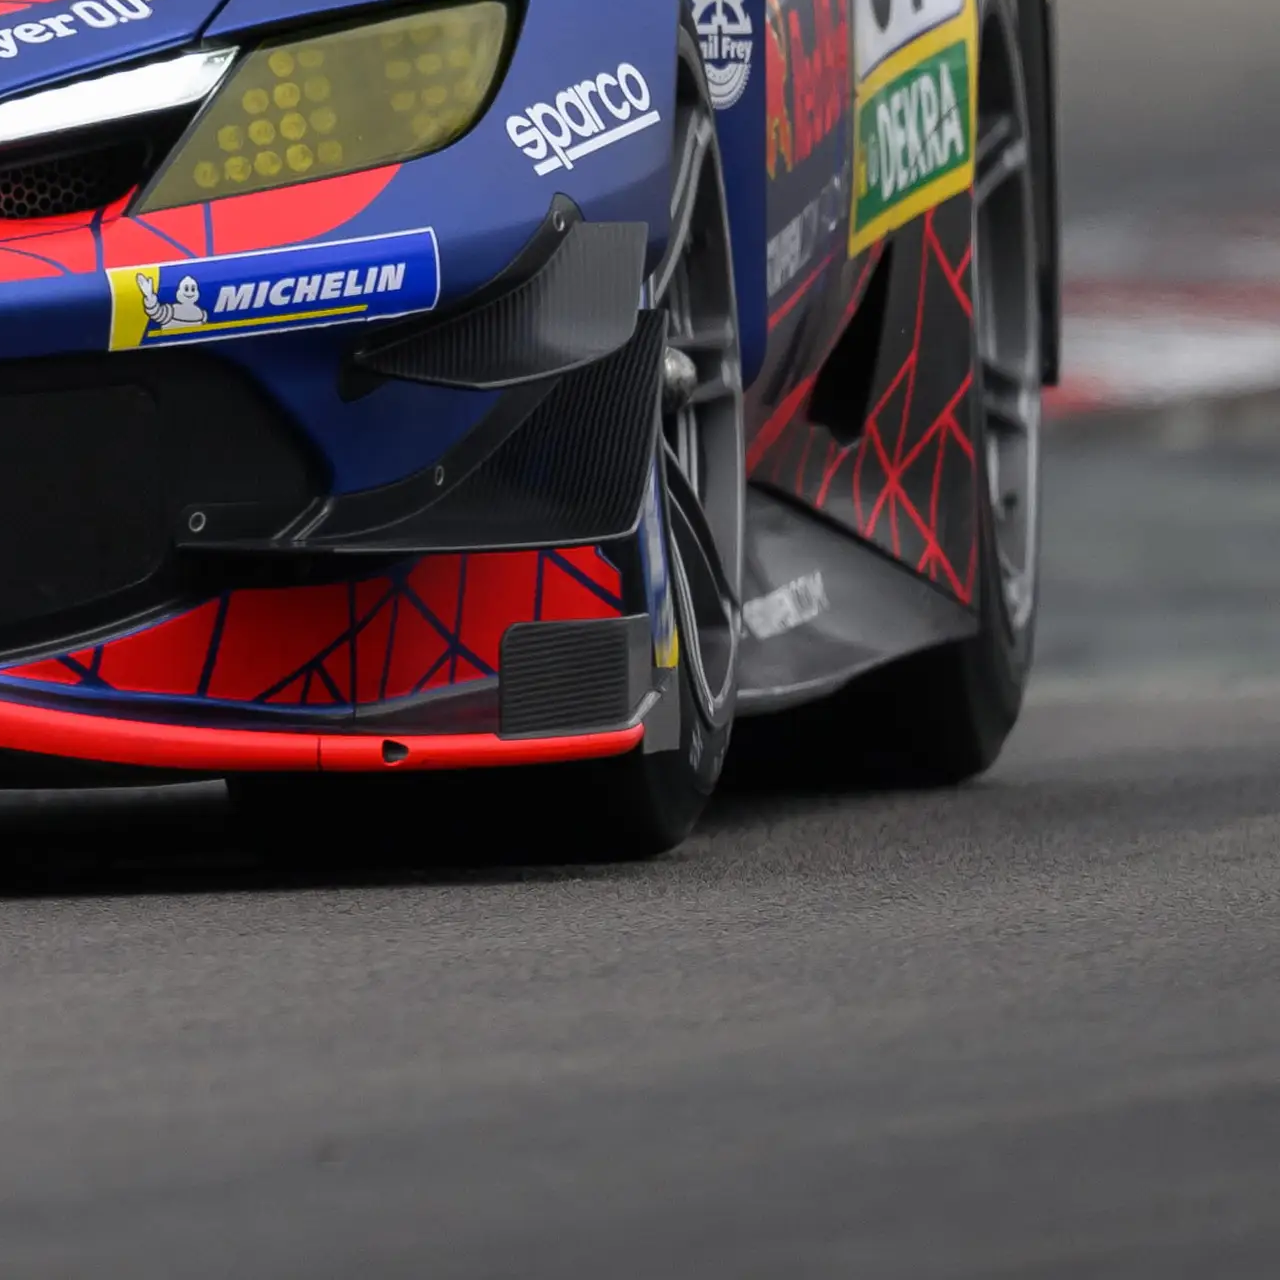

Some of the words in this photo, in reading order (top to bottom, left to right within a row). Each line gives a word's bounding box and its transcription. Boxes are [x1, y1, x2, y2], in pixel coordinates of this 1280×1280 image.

[721, 36, 753, 65] Frey
[505, 62, 651, 171] sparco
[876, 61, 965, 202] DEKRA
[214, 263, 406, 314] MICHELIN
